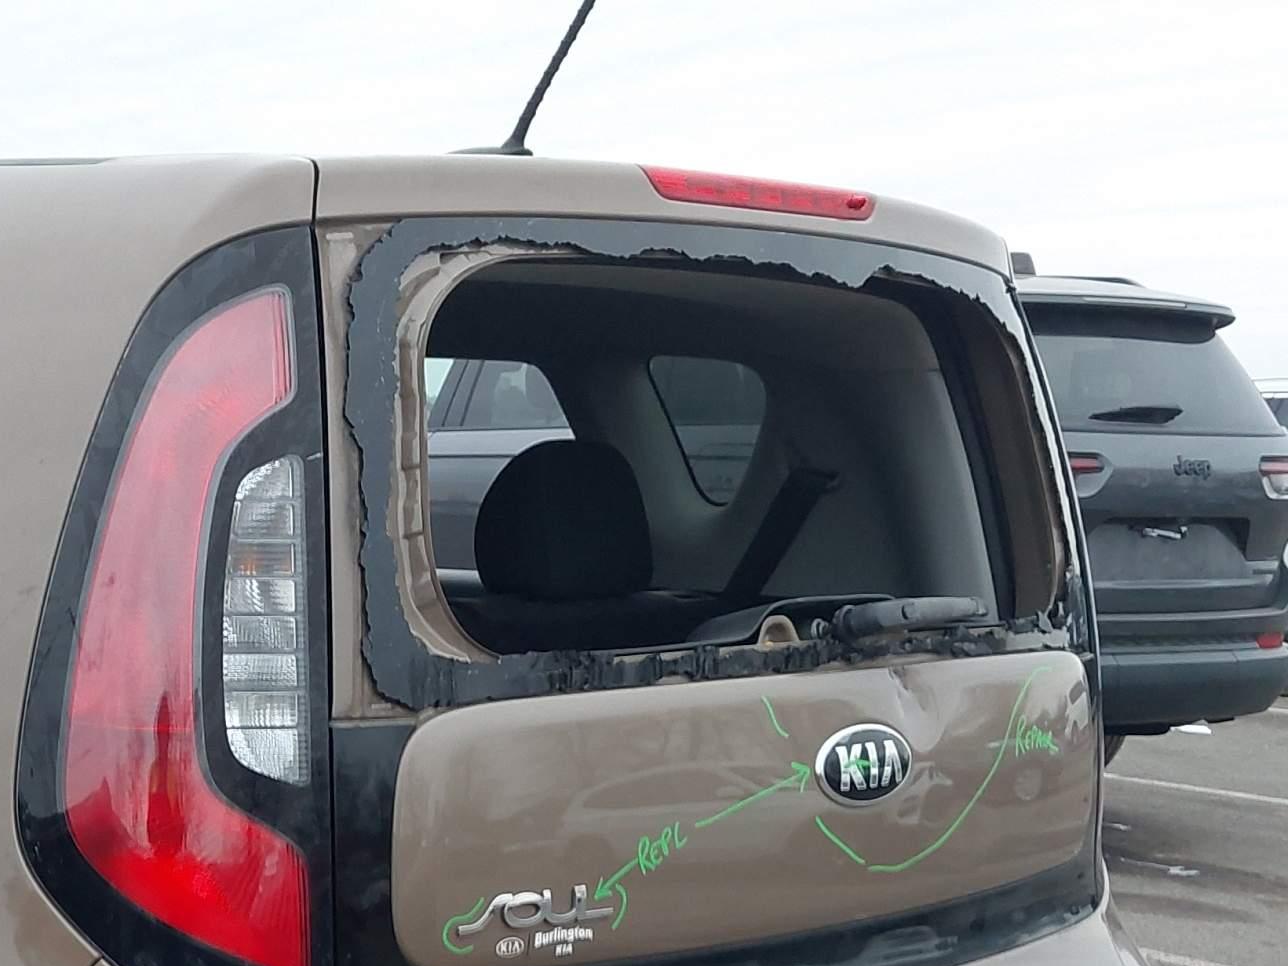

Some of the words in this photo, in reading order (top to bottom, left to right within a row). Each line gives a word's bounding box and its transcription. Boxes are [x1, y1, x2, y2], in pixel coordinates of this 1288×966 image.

[1172, 455, 1212, 479] Jeep
[833, 740, 903, 791] KIA
[458, 885, 614, 936] SOUL
[500, 940, 521, 956] KIA
[533, 926, 592, 949] Burlington
